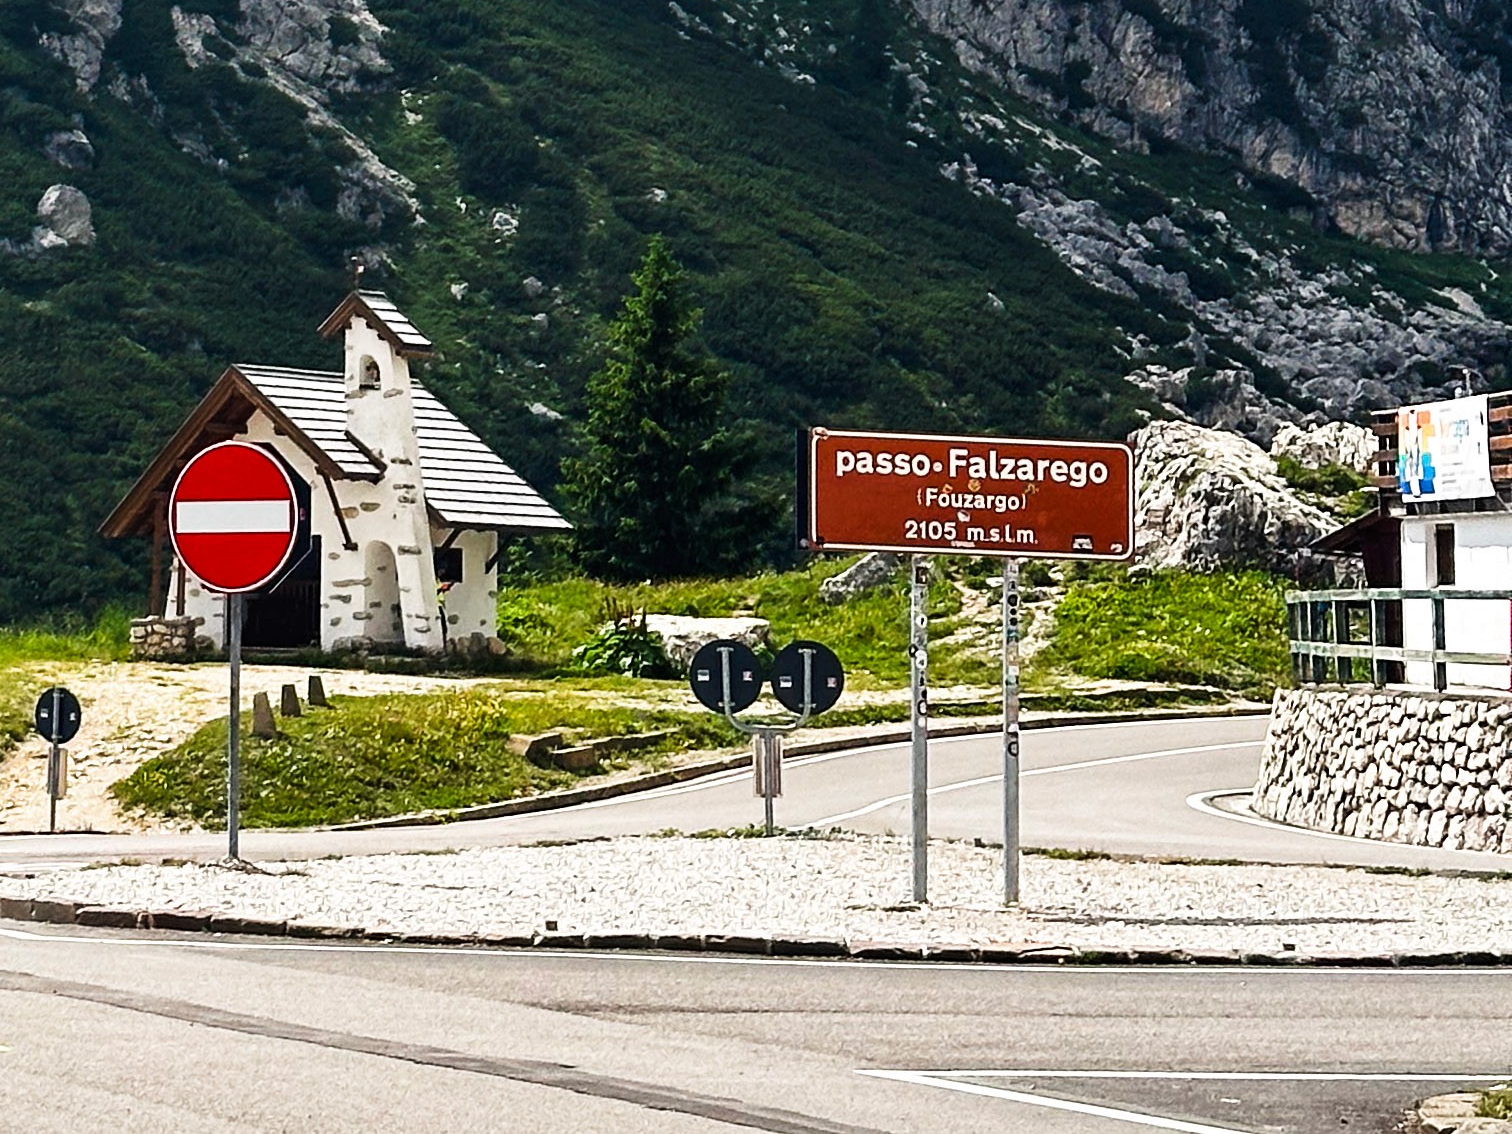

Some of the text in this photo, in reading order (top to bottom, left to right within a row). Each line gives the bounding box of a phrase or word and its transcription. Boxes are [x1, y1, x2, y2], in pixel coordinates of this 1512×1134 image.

[836, 448, 1108, 488] passo Falzarego
[904, 520, 957, 540] 2105
